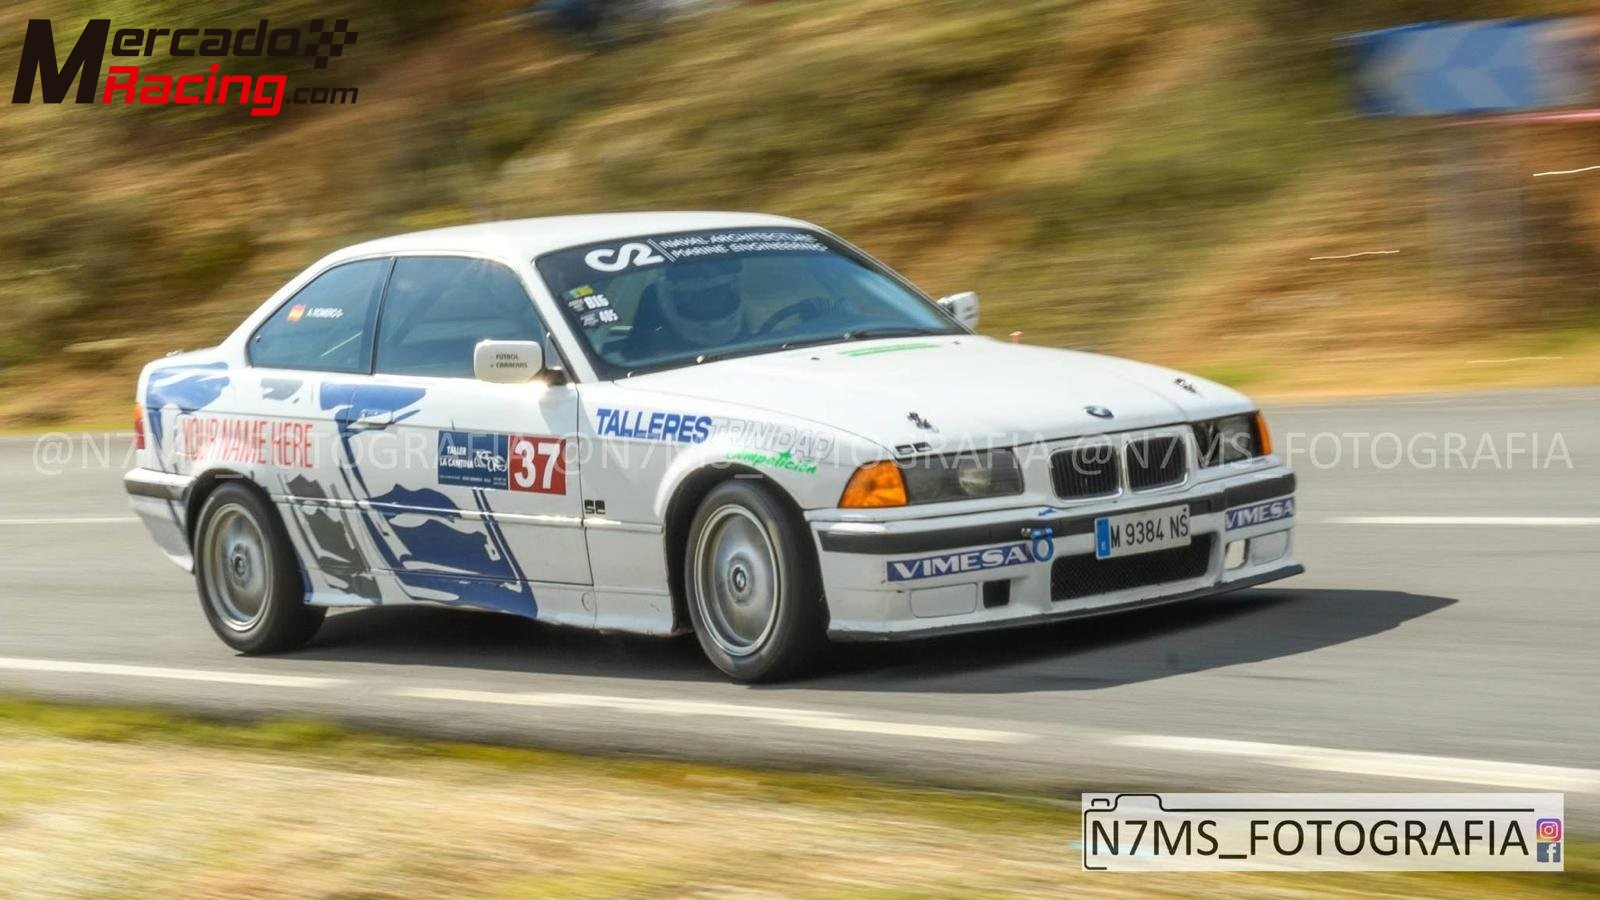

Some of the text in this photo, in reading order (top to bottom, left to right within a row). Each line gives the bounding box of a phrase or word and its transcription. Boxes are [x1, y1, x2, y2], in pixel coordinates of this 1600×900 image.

[181, 417, 314, 469] YOUR NAME HERE
[596, 408, 836, 463] TALLERES TRINIDAD
[513, 440, 562, 490] 37
[1110, 524, 1121, 549] M
[1125, 518, 1165, 546] 9384
[1225, 499, 1294, 529] VIMESA
[893, 545, 1029, 580] VIMESA
